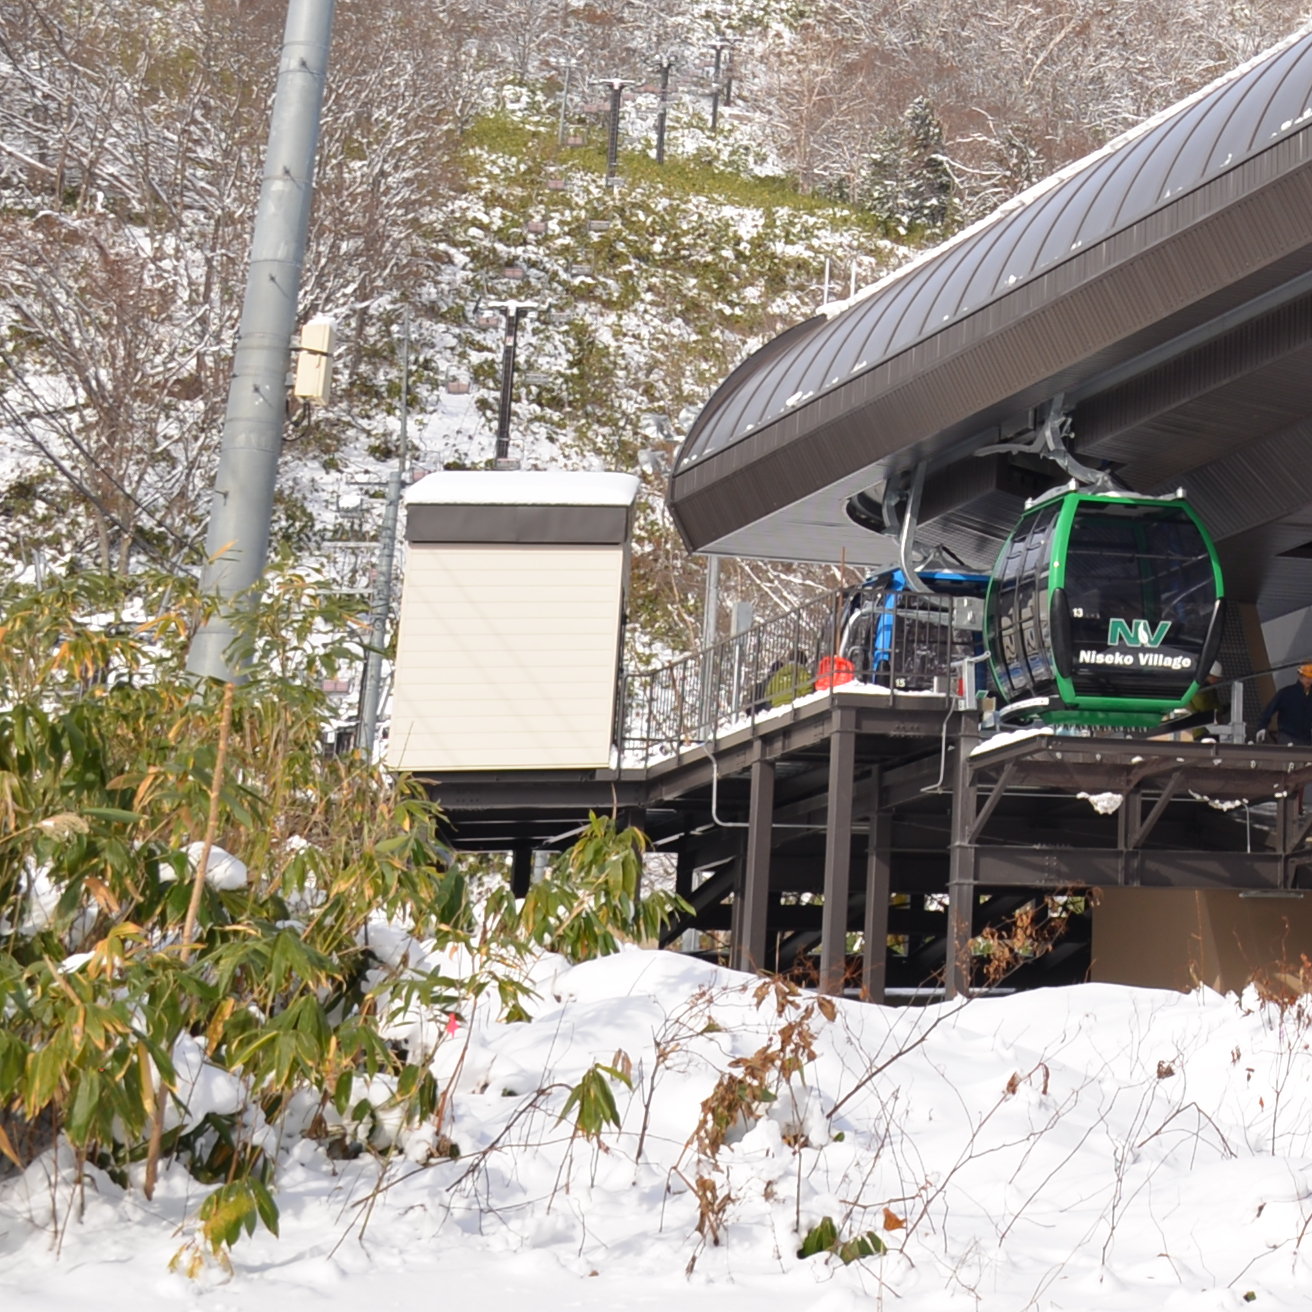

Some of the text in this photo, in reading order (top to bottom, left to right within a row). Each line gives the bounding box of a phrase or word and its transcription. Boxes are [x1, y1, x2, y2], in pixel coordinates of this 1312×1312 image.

[1072, 607, 1084, 618] 13
[1107, 617, 1172, 648] NV
[1079, 649, 1192, 670] Niseko Village
